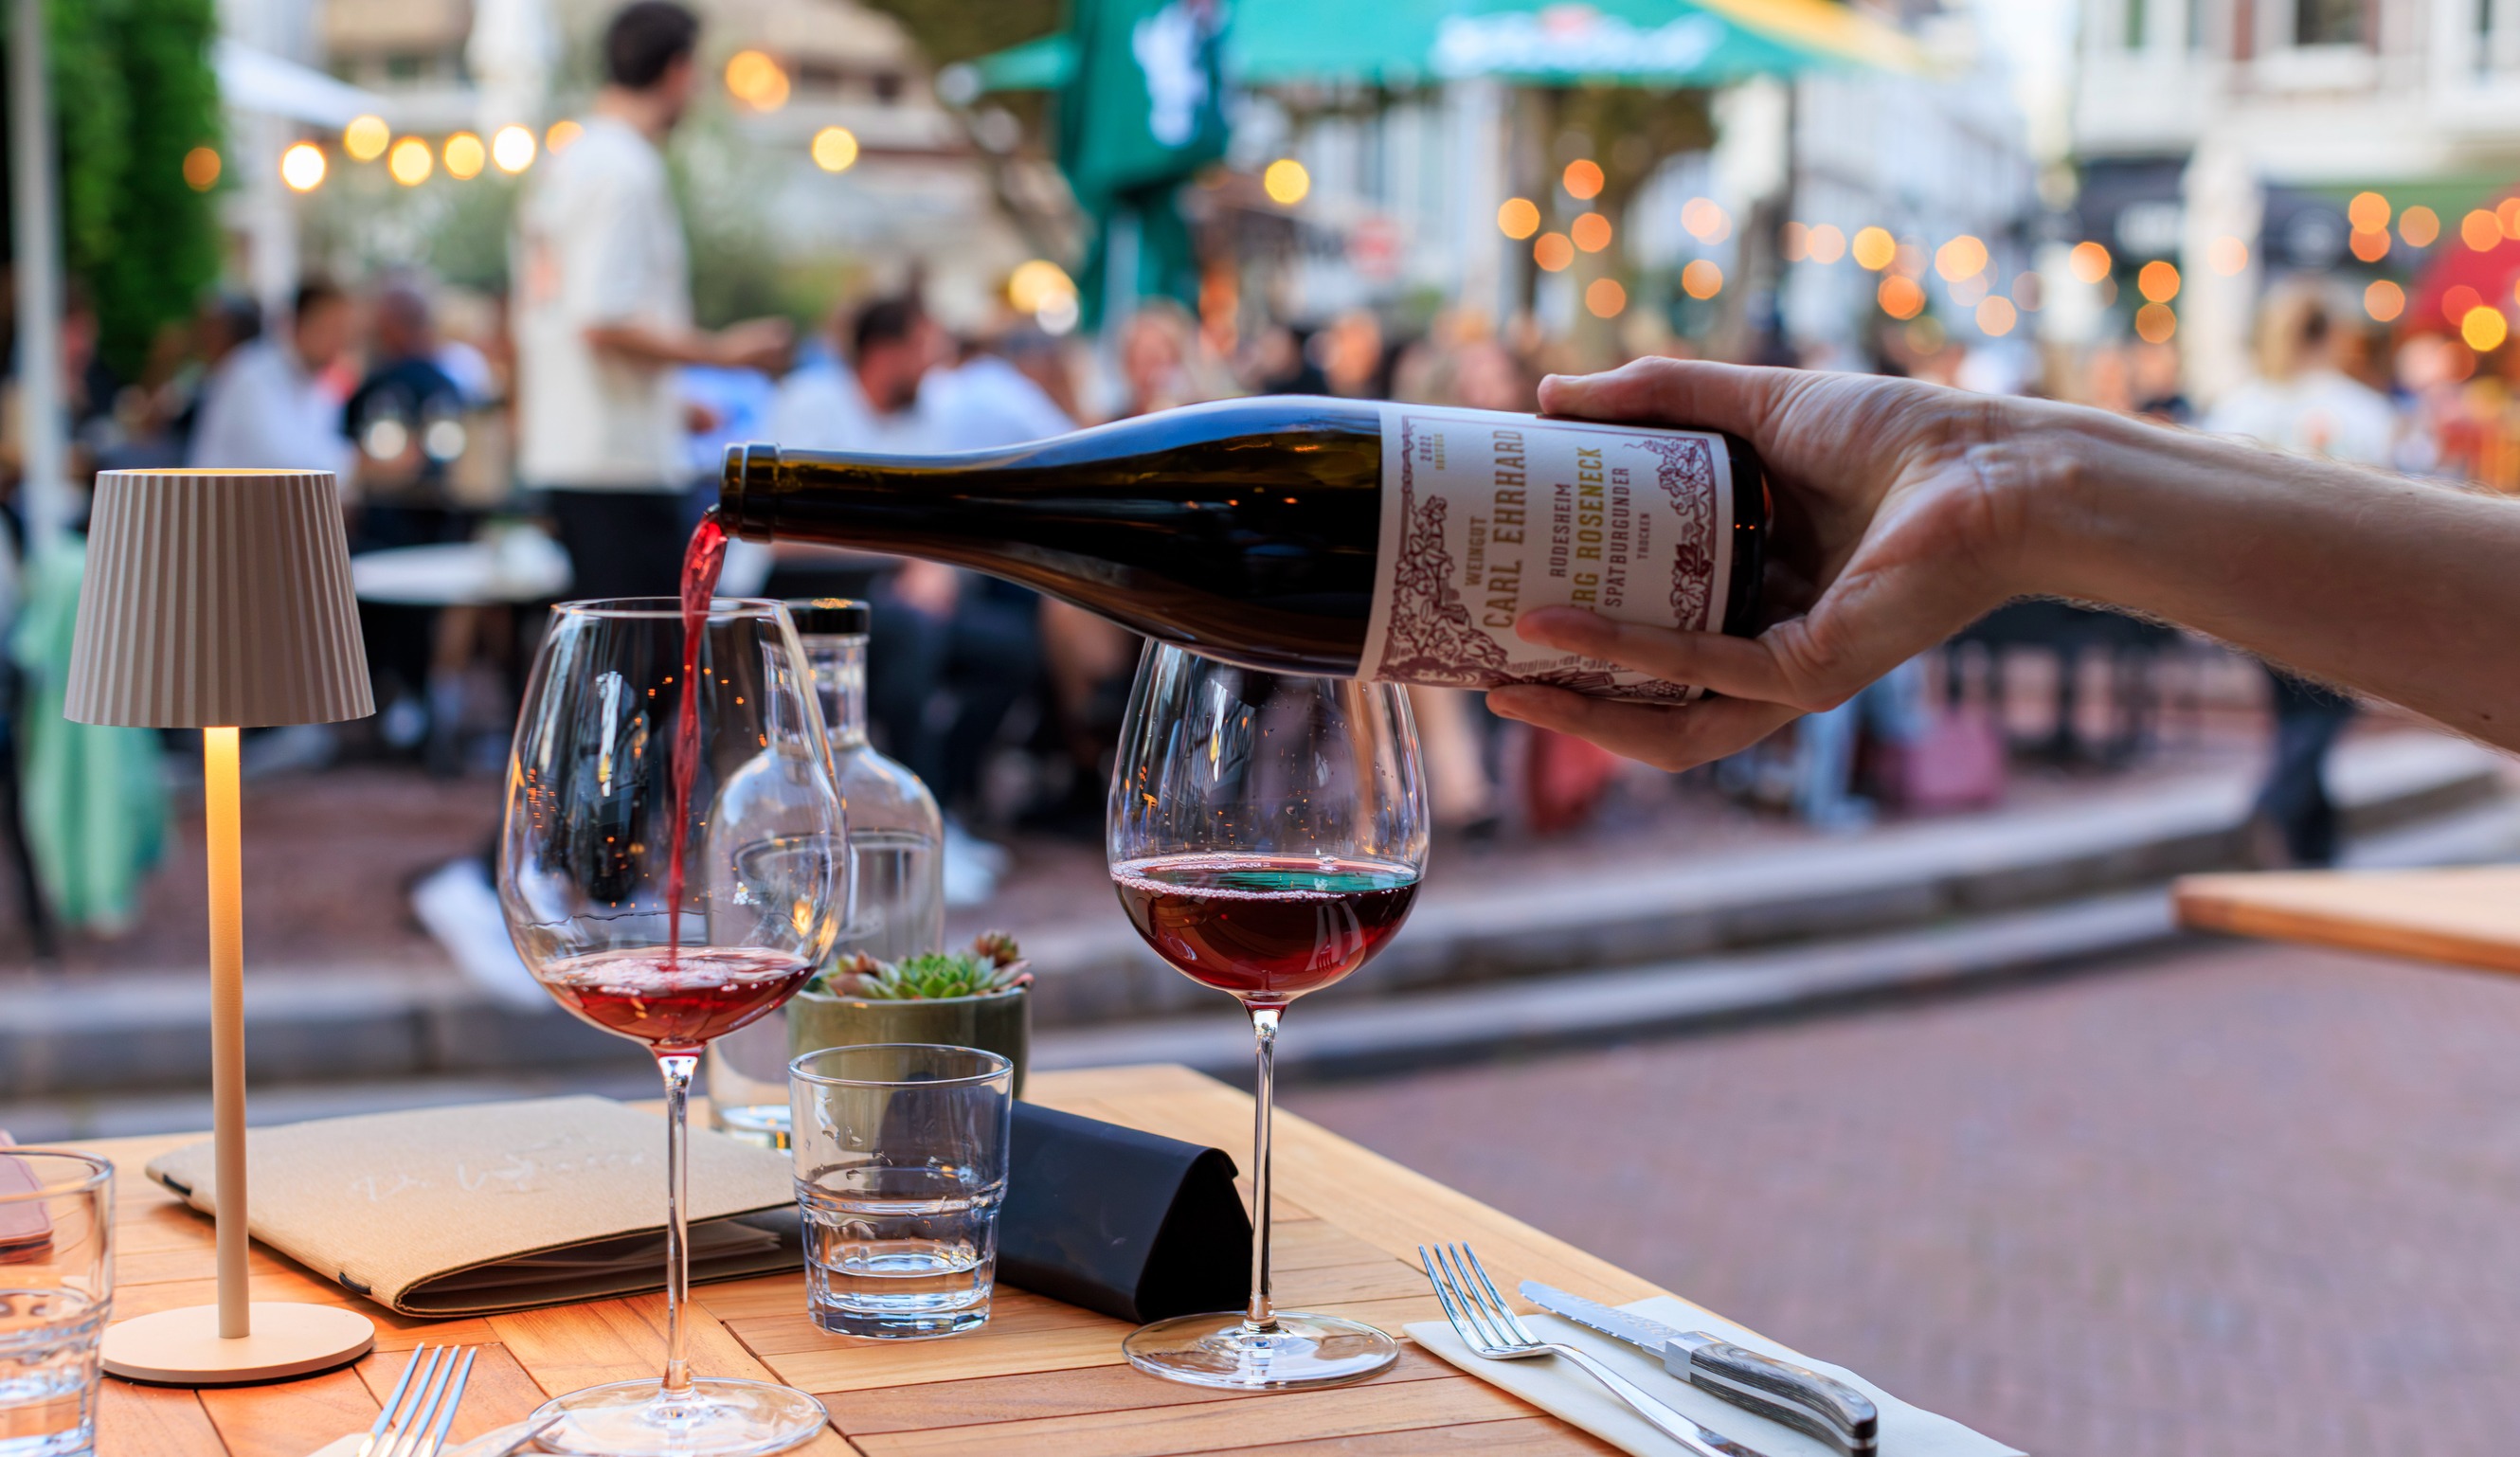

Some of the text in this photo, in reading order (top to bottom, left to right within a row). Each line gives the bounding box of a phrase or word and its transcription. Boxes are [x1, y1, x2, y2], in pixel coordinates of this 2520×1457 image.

[1465, 516, 1487, 586] WEINGUT
[1483, 430, 1527, 628] CARL EHRHARD
[1550, 483, 1572, 578] RÜDESHEIM
[1576, 447, 1605, 562] ROSENECK
[1605, 467, 1630, 608] SPÄTBURGUNDER
[1636, 513, 1651, 560] TROCKEN
